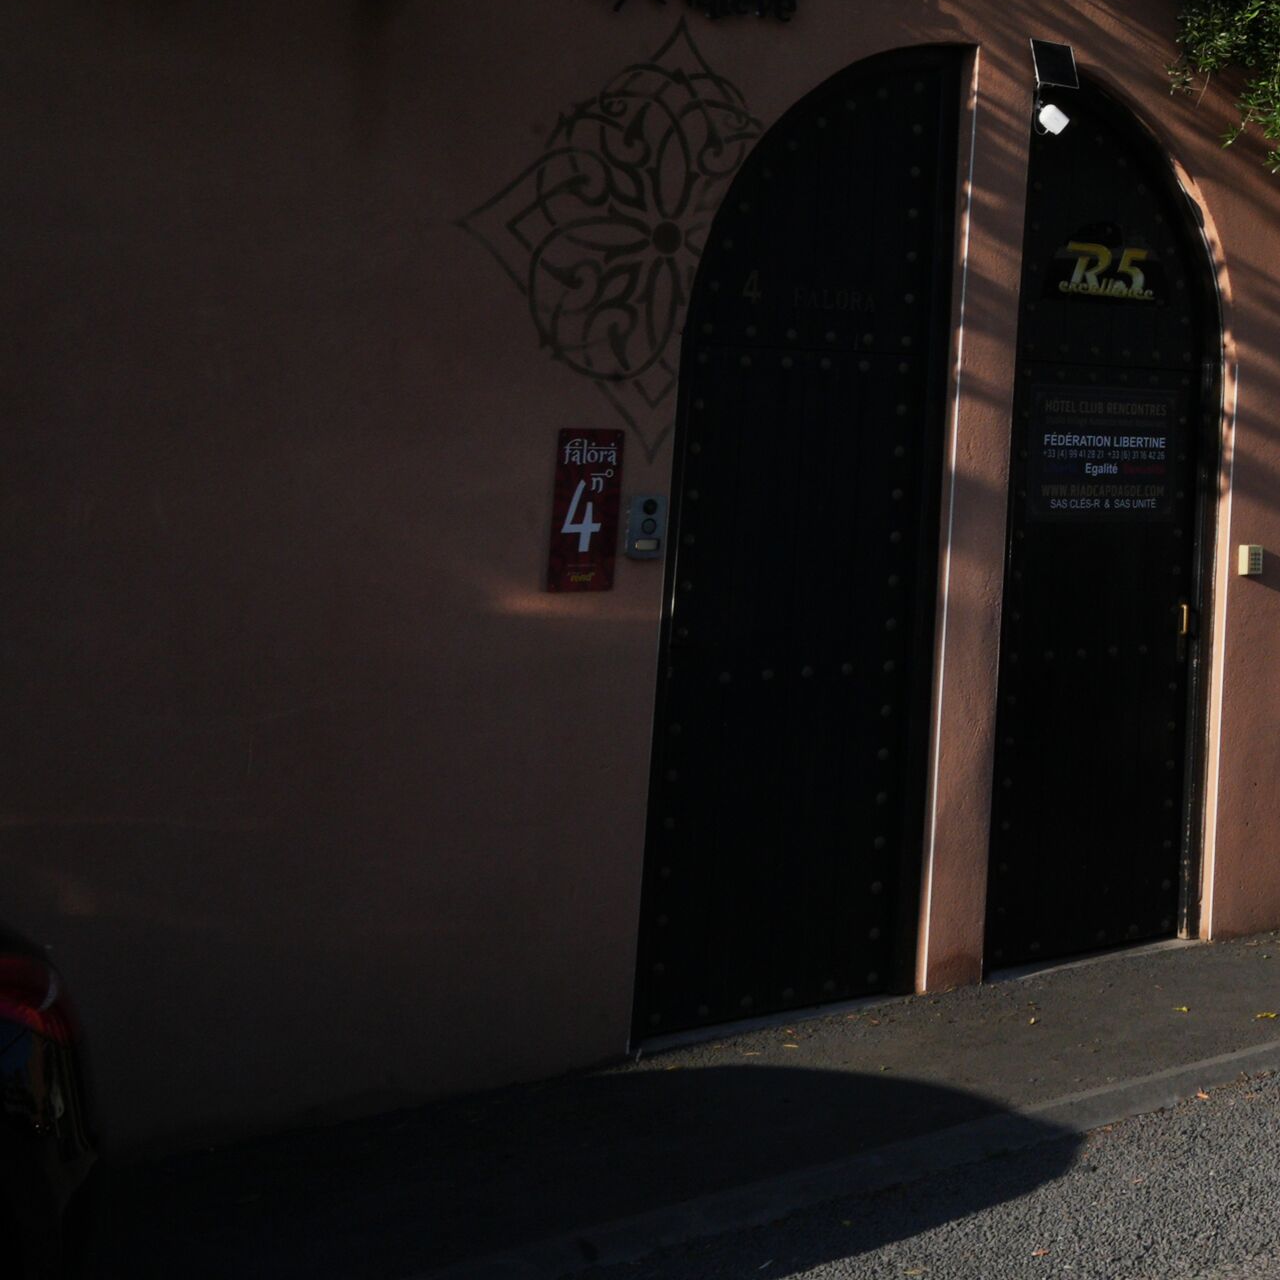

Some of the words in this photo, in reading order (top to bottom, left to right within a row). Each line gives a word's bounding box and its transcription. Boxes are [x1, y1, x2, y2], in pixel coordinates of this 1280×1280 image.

[1065, 240, 1149, 289] R5
[1080, 401, 1104, 414] CLUB
[1107, 402, 1167, 417] RENCONTRES
[1044, 431, 1111, 447] FÉDÉRATION
[1113, 436, 1166, 448] LIBERTINE
[1085, 462, 1118, 476] Egalité
[1050, 499, 1067, 508] SAS
[1114, 499, 1131, 508] SAS
[1132, 498, 1157, 508] UNITÉ
[560, 479, 602, 552] 4
